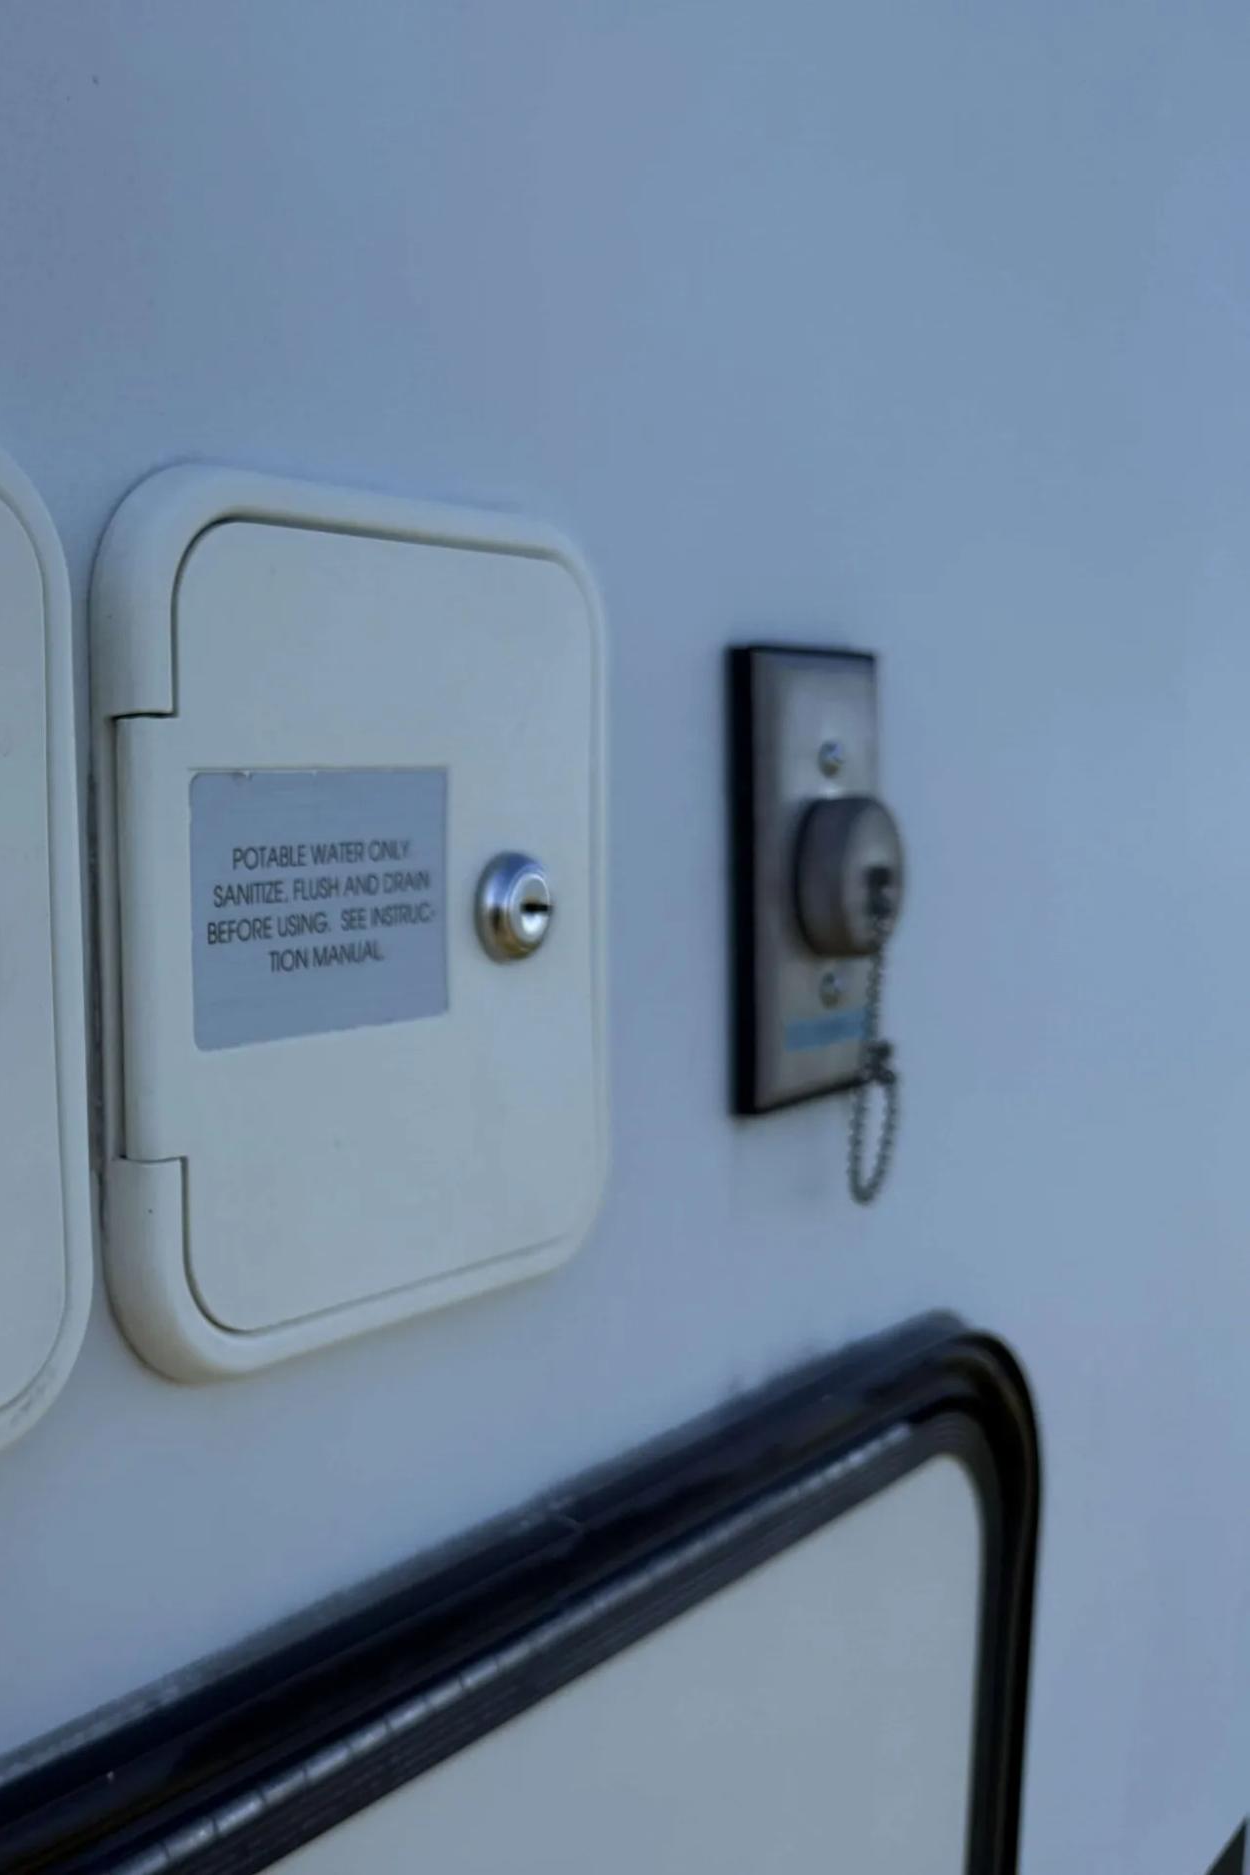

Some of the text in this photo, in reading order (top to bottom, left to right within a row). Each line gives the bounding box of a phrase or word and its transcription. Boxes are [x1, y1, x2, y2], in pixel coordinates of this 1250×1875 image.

[232, 844, 307, 870] POTABLE
[310, 841, 364, 865] WATER
[293, 876, 339, 901] FLUSH
[343, 873, 378, 897] AND
[382, 870, 431, 894] DRAIN
[207, 902, 437, 945] BEFORE USING. SEE INSTRUC-
[268, 948, 308, 972] TION
